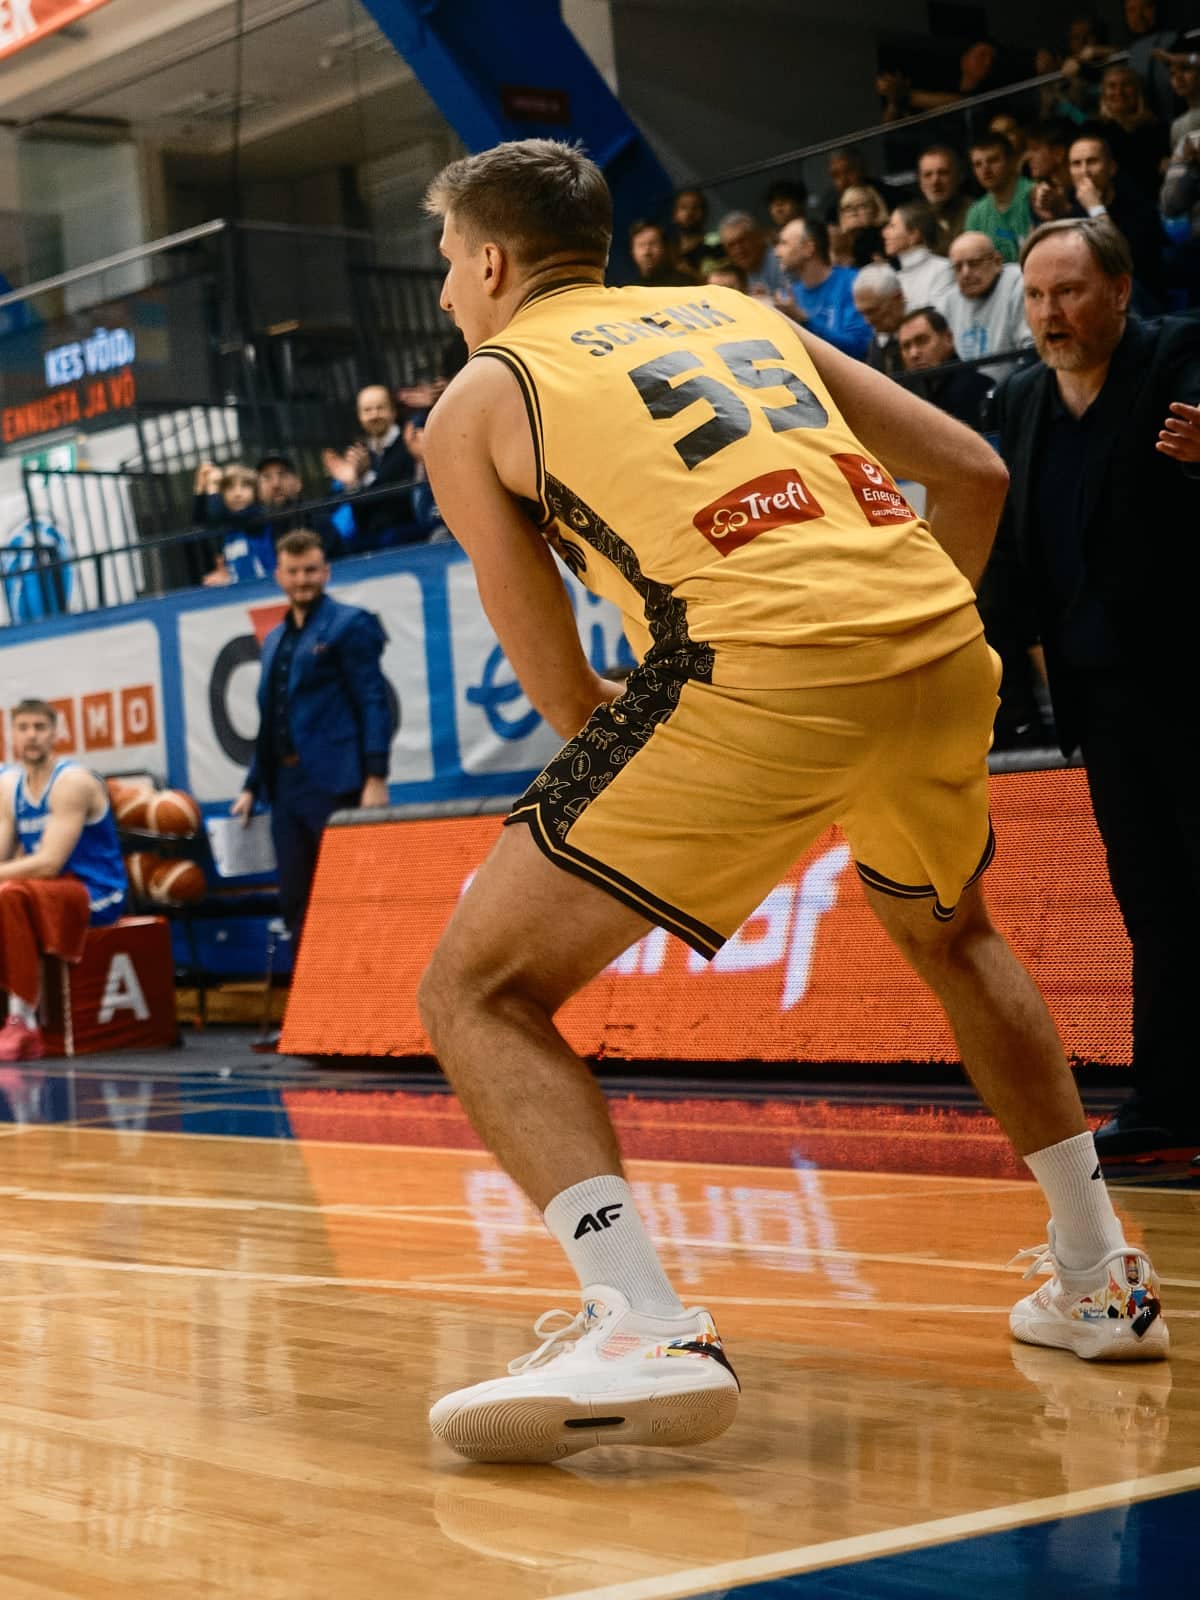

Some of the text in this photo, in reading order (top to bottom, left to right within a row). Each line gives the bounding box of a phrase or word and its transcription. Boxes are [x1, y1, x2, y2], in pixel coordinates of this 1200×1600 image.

[570, 299, 737, 357] SCHENK
[627, 338, 829, 472] 55
[740, 481, 809, 520] Trefl
[97, 952, 150, 1023] A
